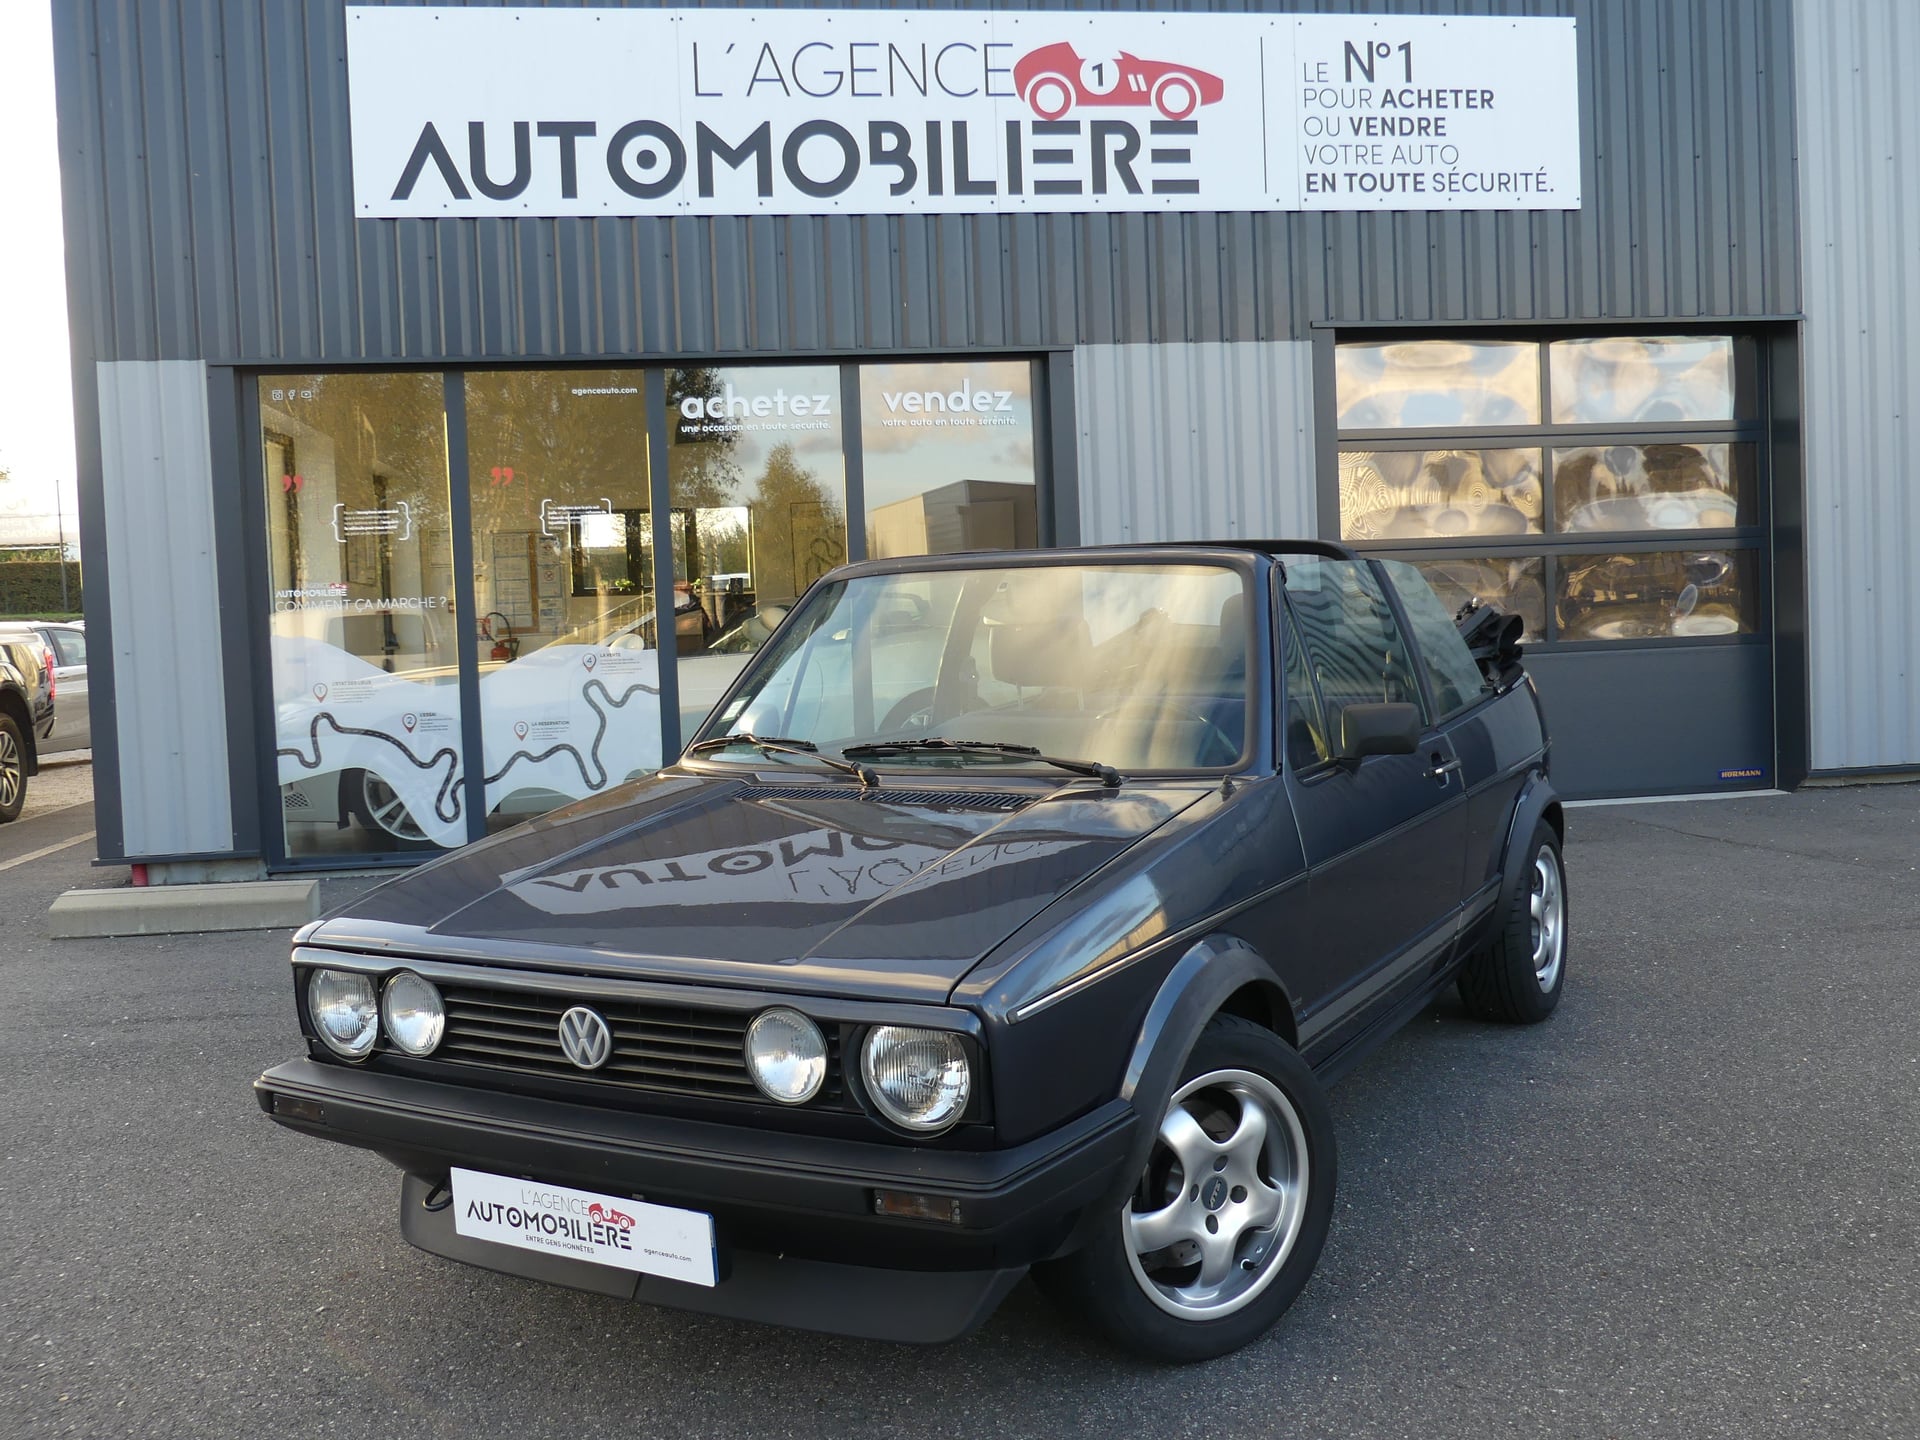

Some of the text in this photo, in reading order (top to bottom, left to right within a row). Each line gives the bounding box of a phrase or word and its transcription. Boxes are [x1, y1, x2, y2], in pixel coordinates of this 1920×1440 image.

[693, 41, 1016, 98] L'AGENCE
[1091, 63, 1105, 88] 1
[1303, 62, 1329, 82] LE
[1303, 88, 1495, 109] POUR ACHETER
[1303, 116, 1447, 137] OU VENDRE
[1304, 144, 1459, 165] VOTRE AUTO
[1306, 166, 1555, 193] EN TOUTE SÉCURITÉ.
[571, 386, 639, 397] agenceauto.com
[680, 383, 831, 420] achetez
[881, 378, 1013, 413] vendez
[681, 425, 700, 434] une
[702, 422, 743, 433] occasion
[747, 423, 759, 431] en
[761, 421, 787, 431] toute
[881, 417, 907, 427] votre
[910, 417, 932, 427] auto
[935, 418, 947, 426] en
[950, 416, 975, 426] toute
[275, 596, 447, 613] COMMENT ÇA MARCHE ?
[559, 1006, 612, 1070] VW
[521, 1187, 589, 1217] L'AGENCE
[525, 1234, 545, 1245] ENTRE
[545, 1237, 562, 1248] GENS
[643, 1247, 692, 1263] agenceauto.com
